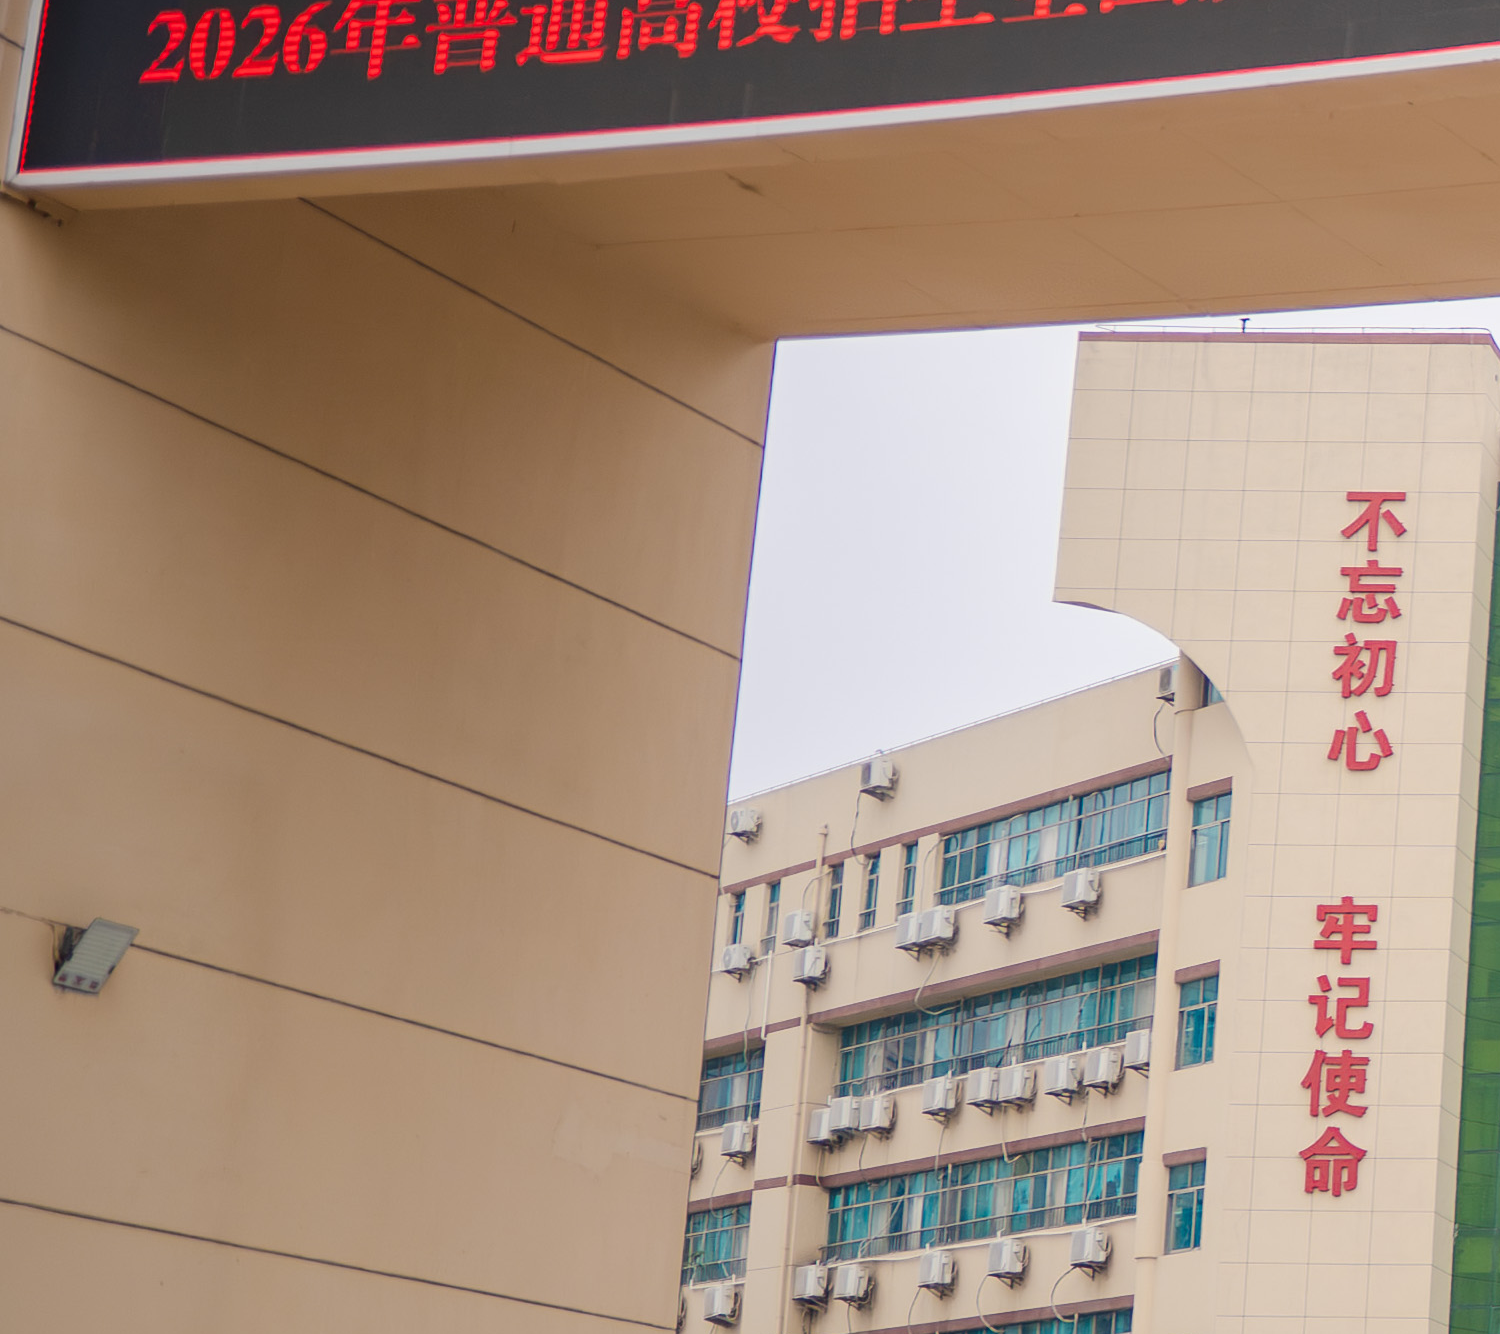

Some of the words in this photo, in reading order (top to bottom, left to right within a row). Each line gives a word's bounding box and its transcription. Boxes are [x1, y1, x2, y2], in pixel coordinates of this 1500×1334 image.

[1326, 490, 1408, 772] 不忘初心
[1298, 896, 1379, 1198] 牢记使命
